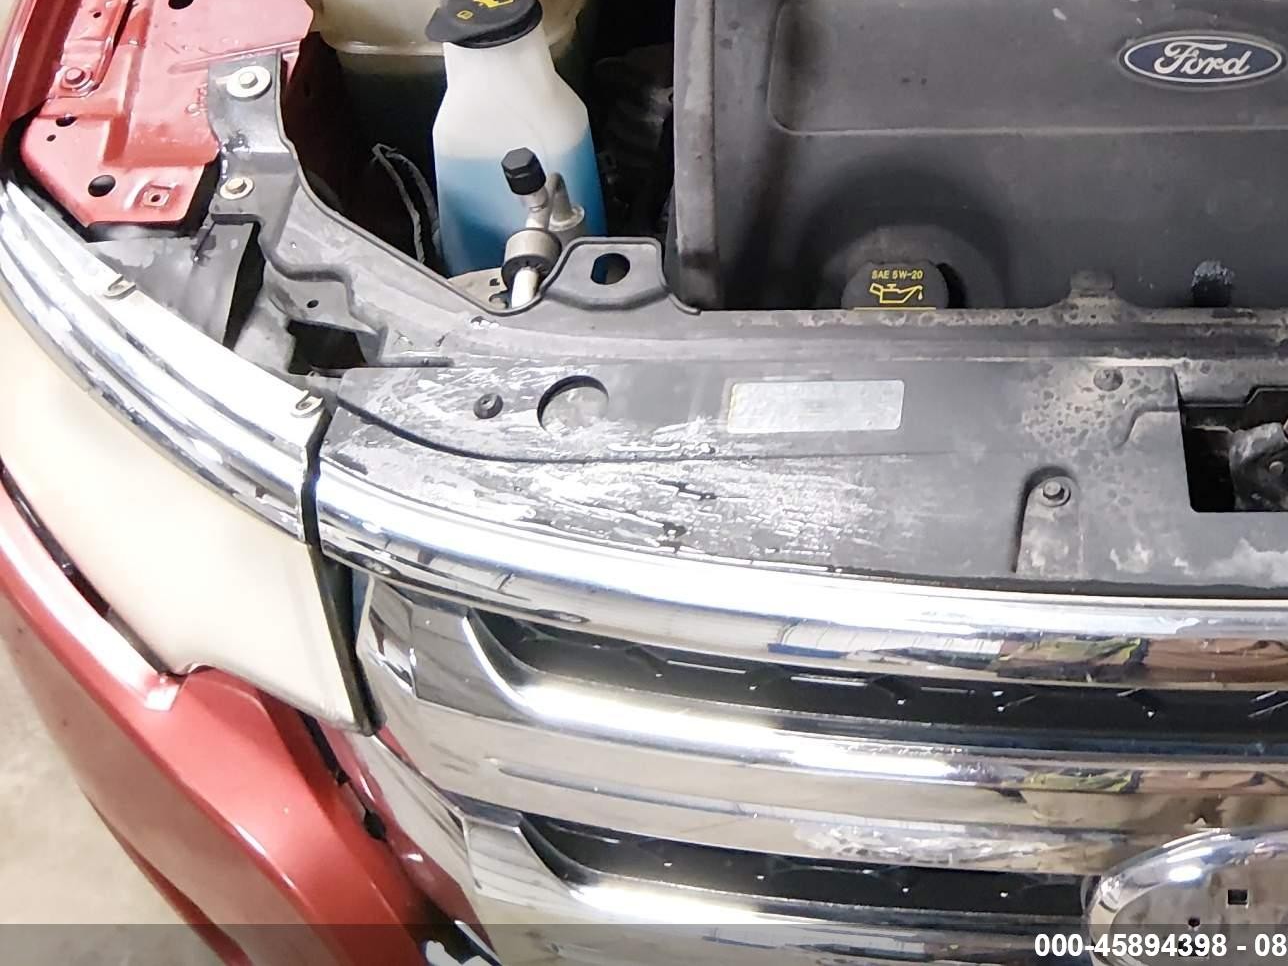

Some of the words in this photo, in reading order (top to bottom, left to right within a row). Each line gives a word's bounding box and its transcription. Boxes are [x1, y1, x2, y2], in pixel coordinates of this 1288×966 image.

[1153, 41, 1253, 76] Ford
[871, 269, 890, 280] SAE
[892, 269, 924, 280] 5W-20
